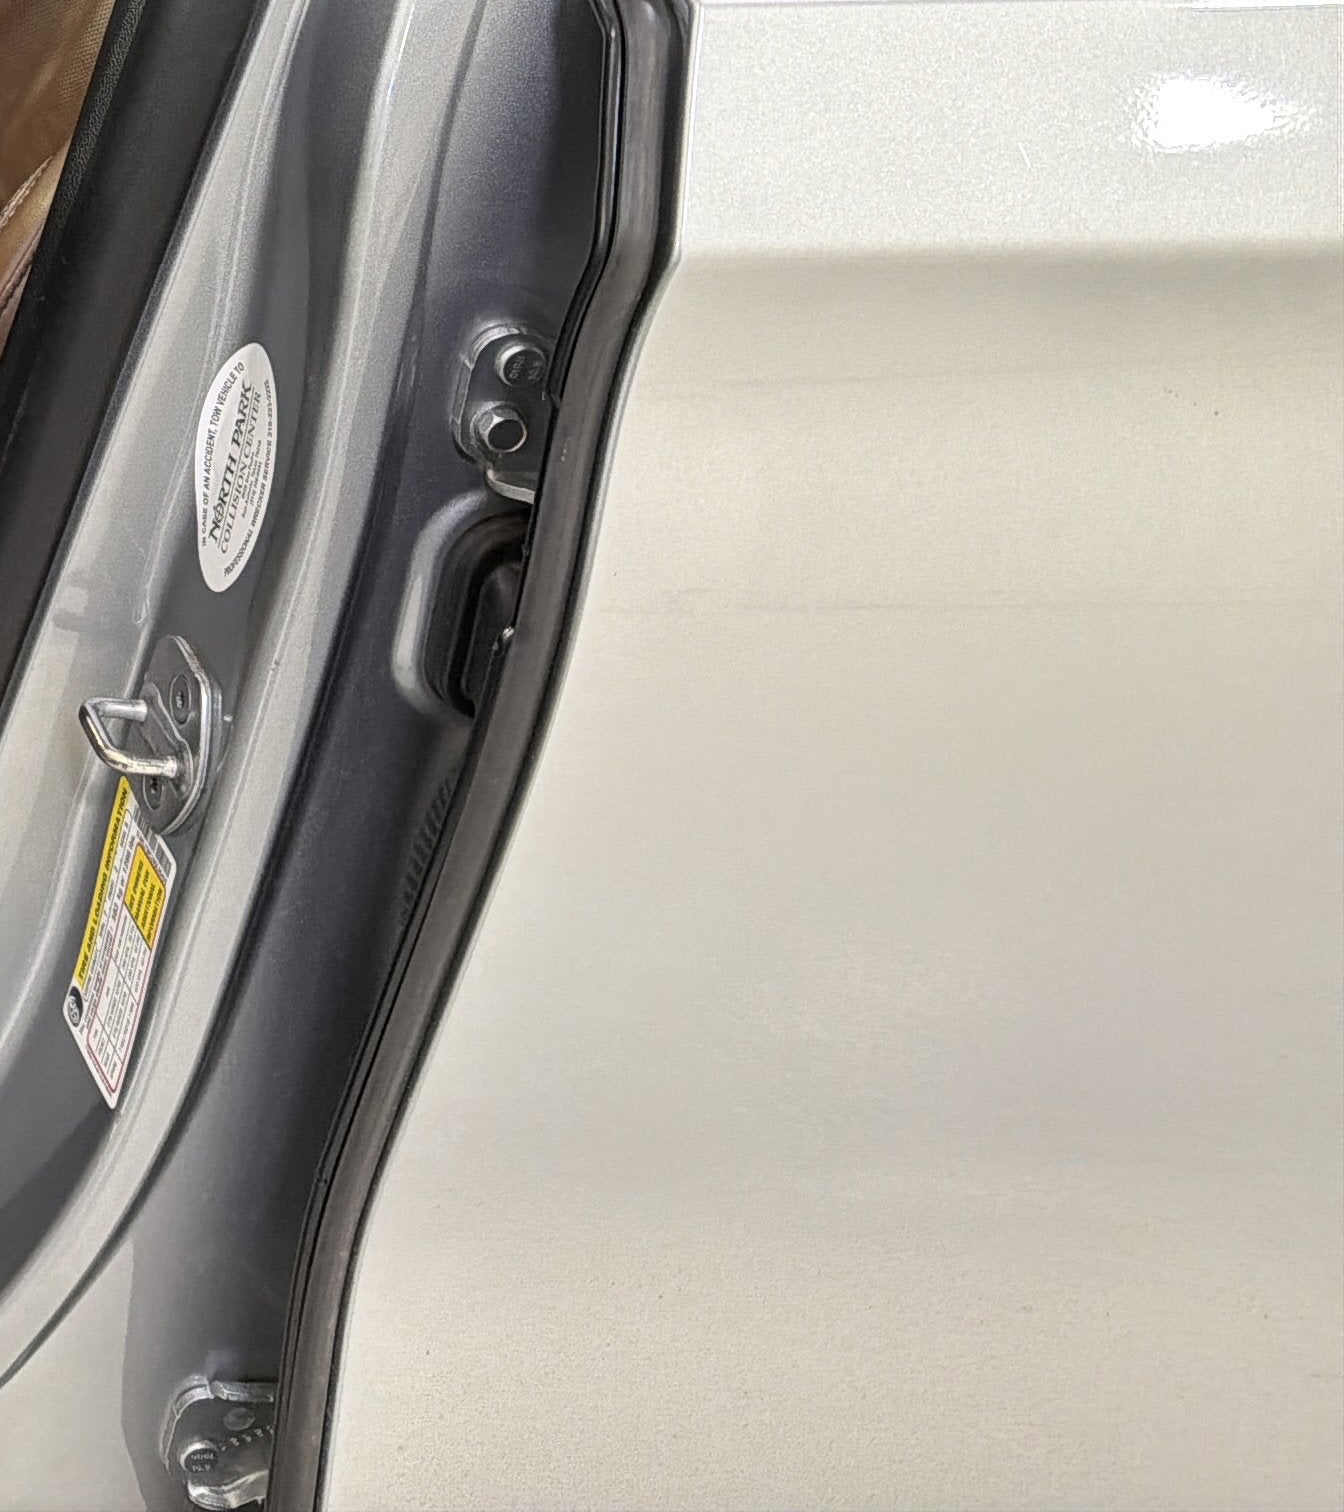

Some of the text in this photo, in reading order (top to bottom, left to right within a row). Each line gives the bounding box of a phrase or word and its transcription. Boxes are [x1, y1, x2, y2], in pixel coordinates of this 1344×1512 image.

[234, 362, 245, 375] TO
[216, 372, 238, 406] VEHICLE
[210, 406, 222, 427] TOW
[208, 378, 253, 544] NORTH PARK
[220, 461, 248, 555] COLLISION
[243, 391, 261, 459] CENTER
[203, 476, 211, 491] AN
[202, 492, 210, 505] OF
[224, 529, 254, 577] PROFESSIONAL
[252, 482, 266, 527] WRECKER
[263, 440, 273, 482] SERVICE
